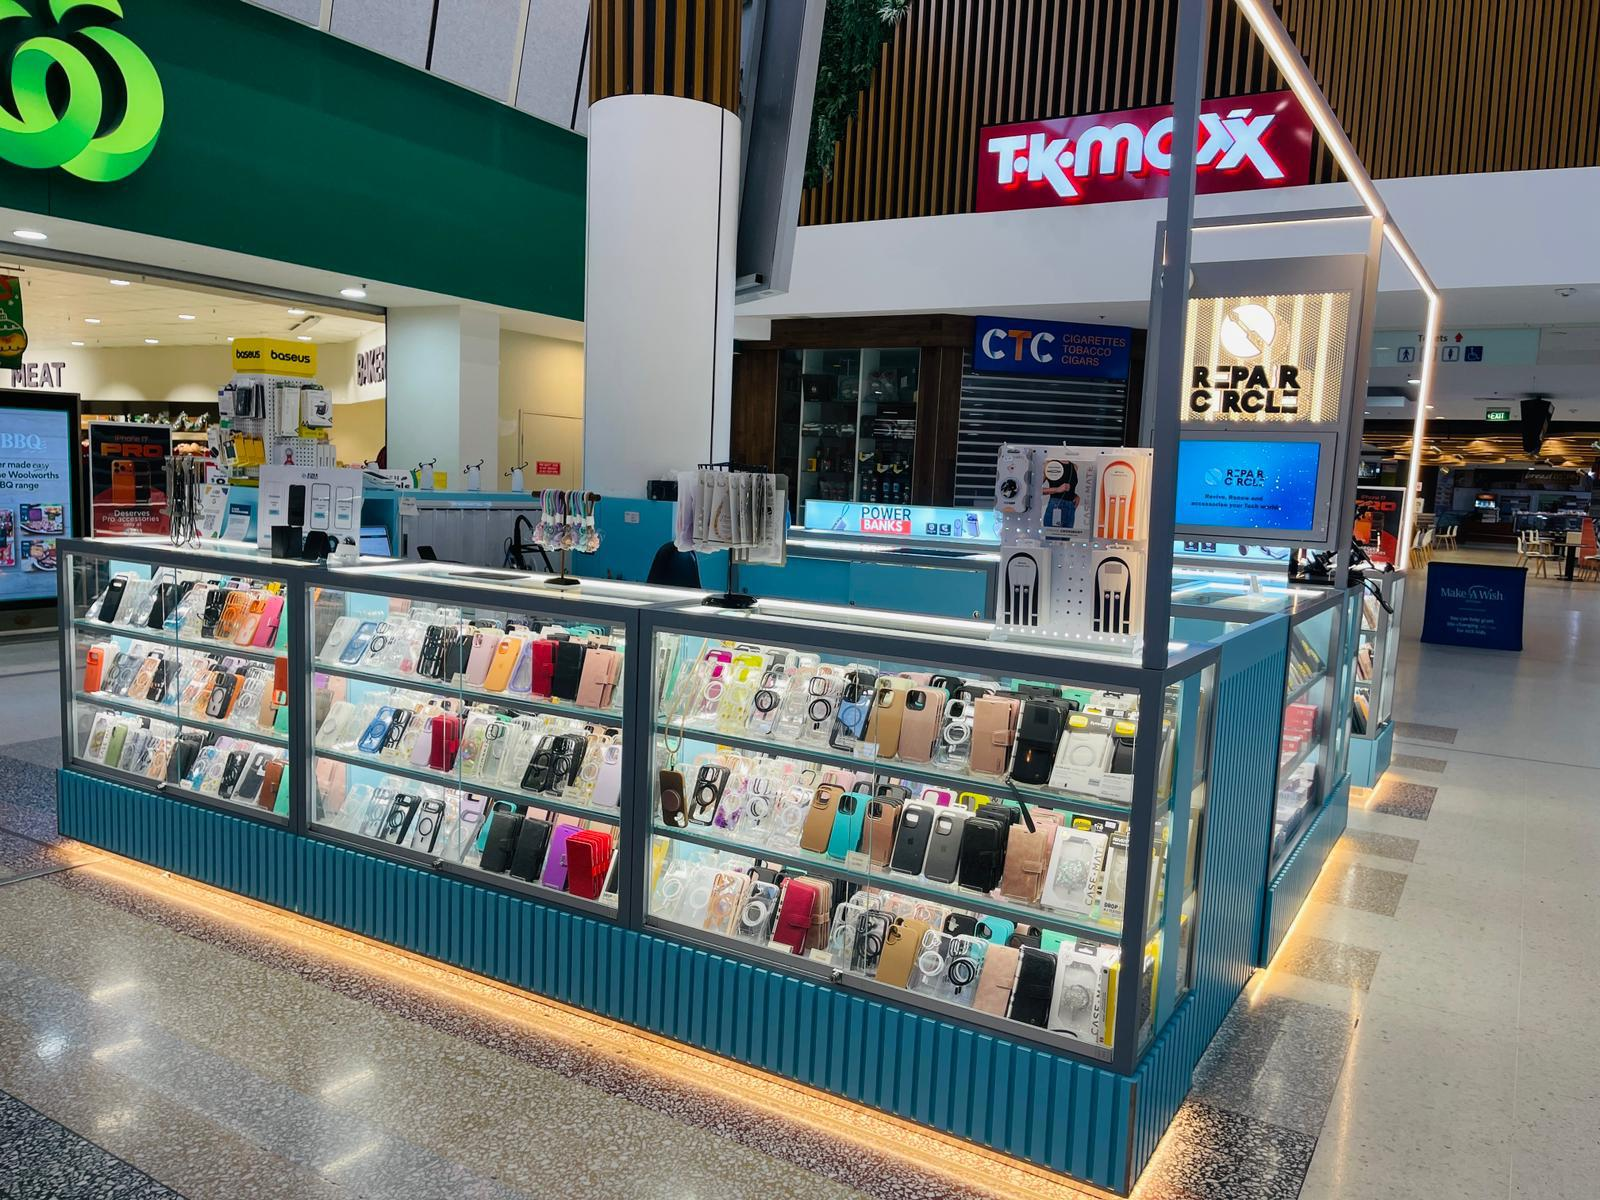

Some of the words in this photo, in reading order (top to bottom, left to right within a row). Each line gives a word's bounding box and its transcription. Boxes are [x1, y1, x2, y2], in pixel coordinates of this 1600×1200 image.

[982, 328, 1056, 363] CTC
[1063, 334, 1126, 347] CIGARETTES
[236, 348, 260, 359] baseus
[271, 349, 310, 364] baseus
[1062, 344, 1112, 357] TOBACCO
[1061, 355, 1100, 367] CIGARS
[11, 362, 66, 388] MEAT
[1192, 365, 1301, 389] REPAIR
[1190, 389, 1298, 413] CIRCLE
[1490, 412, 1504, 420] EXIT
[1, 432, 43, 450] BBQ
[100, 442, 163, 457] PRO
[8, 461, 31, 469] made
[32, 462, 49, 471] easy
[8, 471, 60, 480] Woolworths
[15, 483, 39, 492] range
[113, 509, 150, 517] Deserves
[861, 506, 911, 521] POWER
[864, 518, 903, 532] BANKS
[1440, 587, 1467, 598] Make
[1479, 588, 1503, 601] Wish
